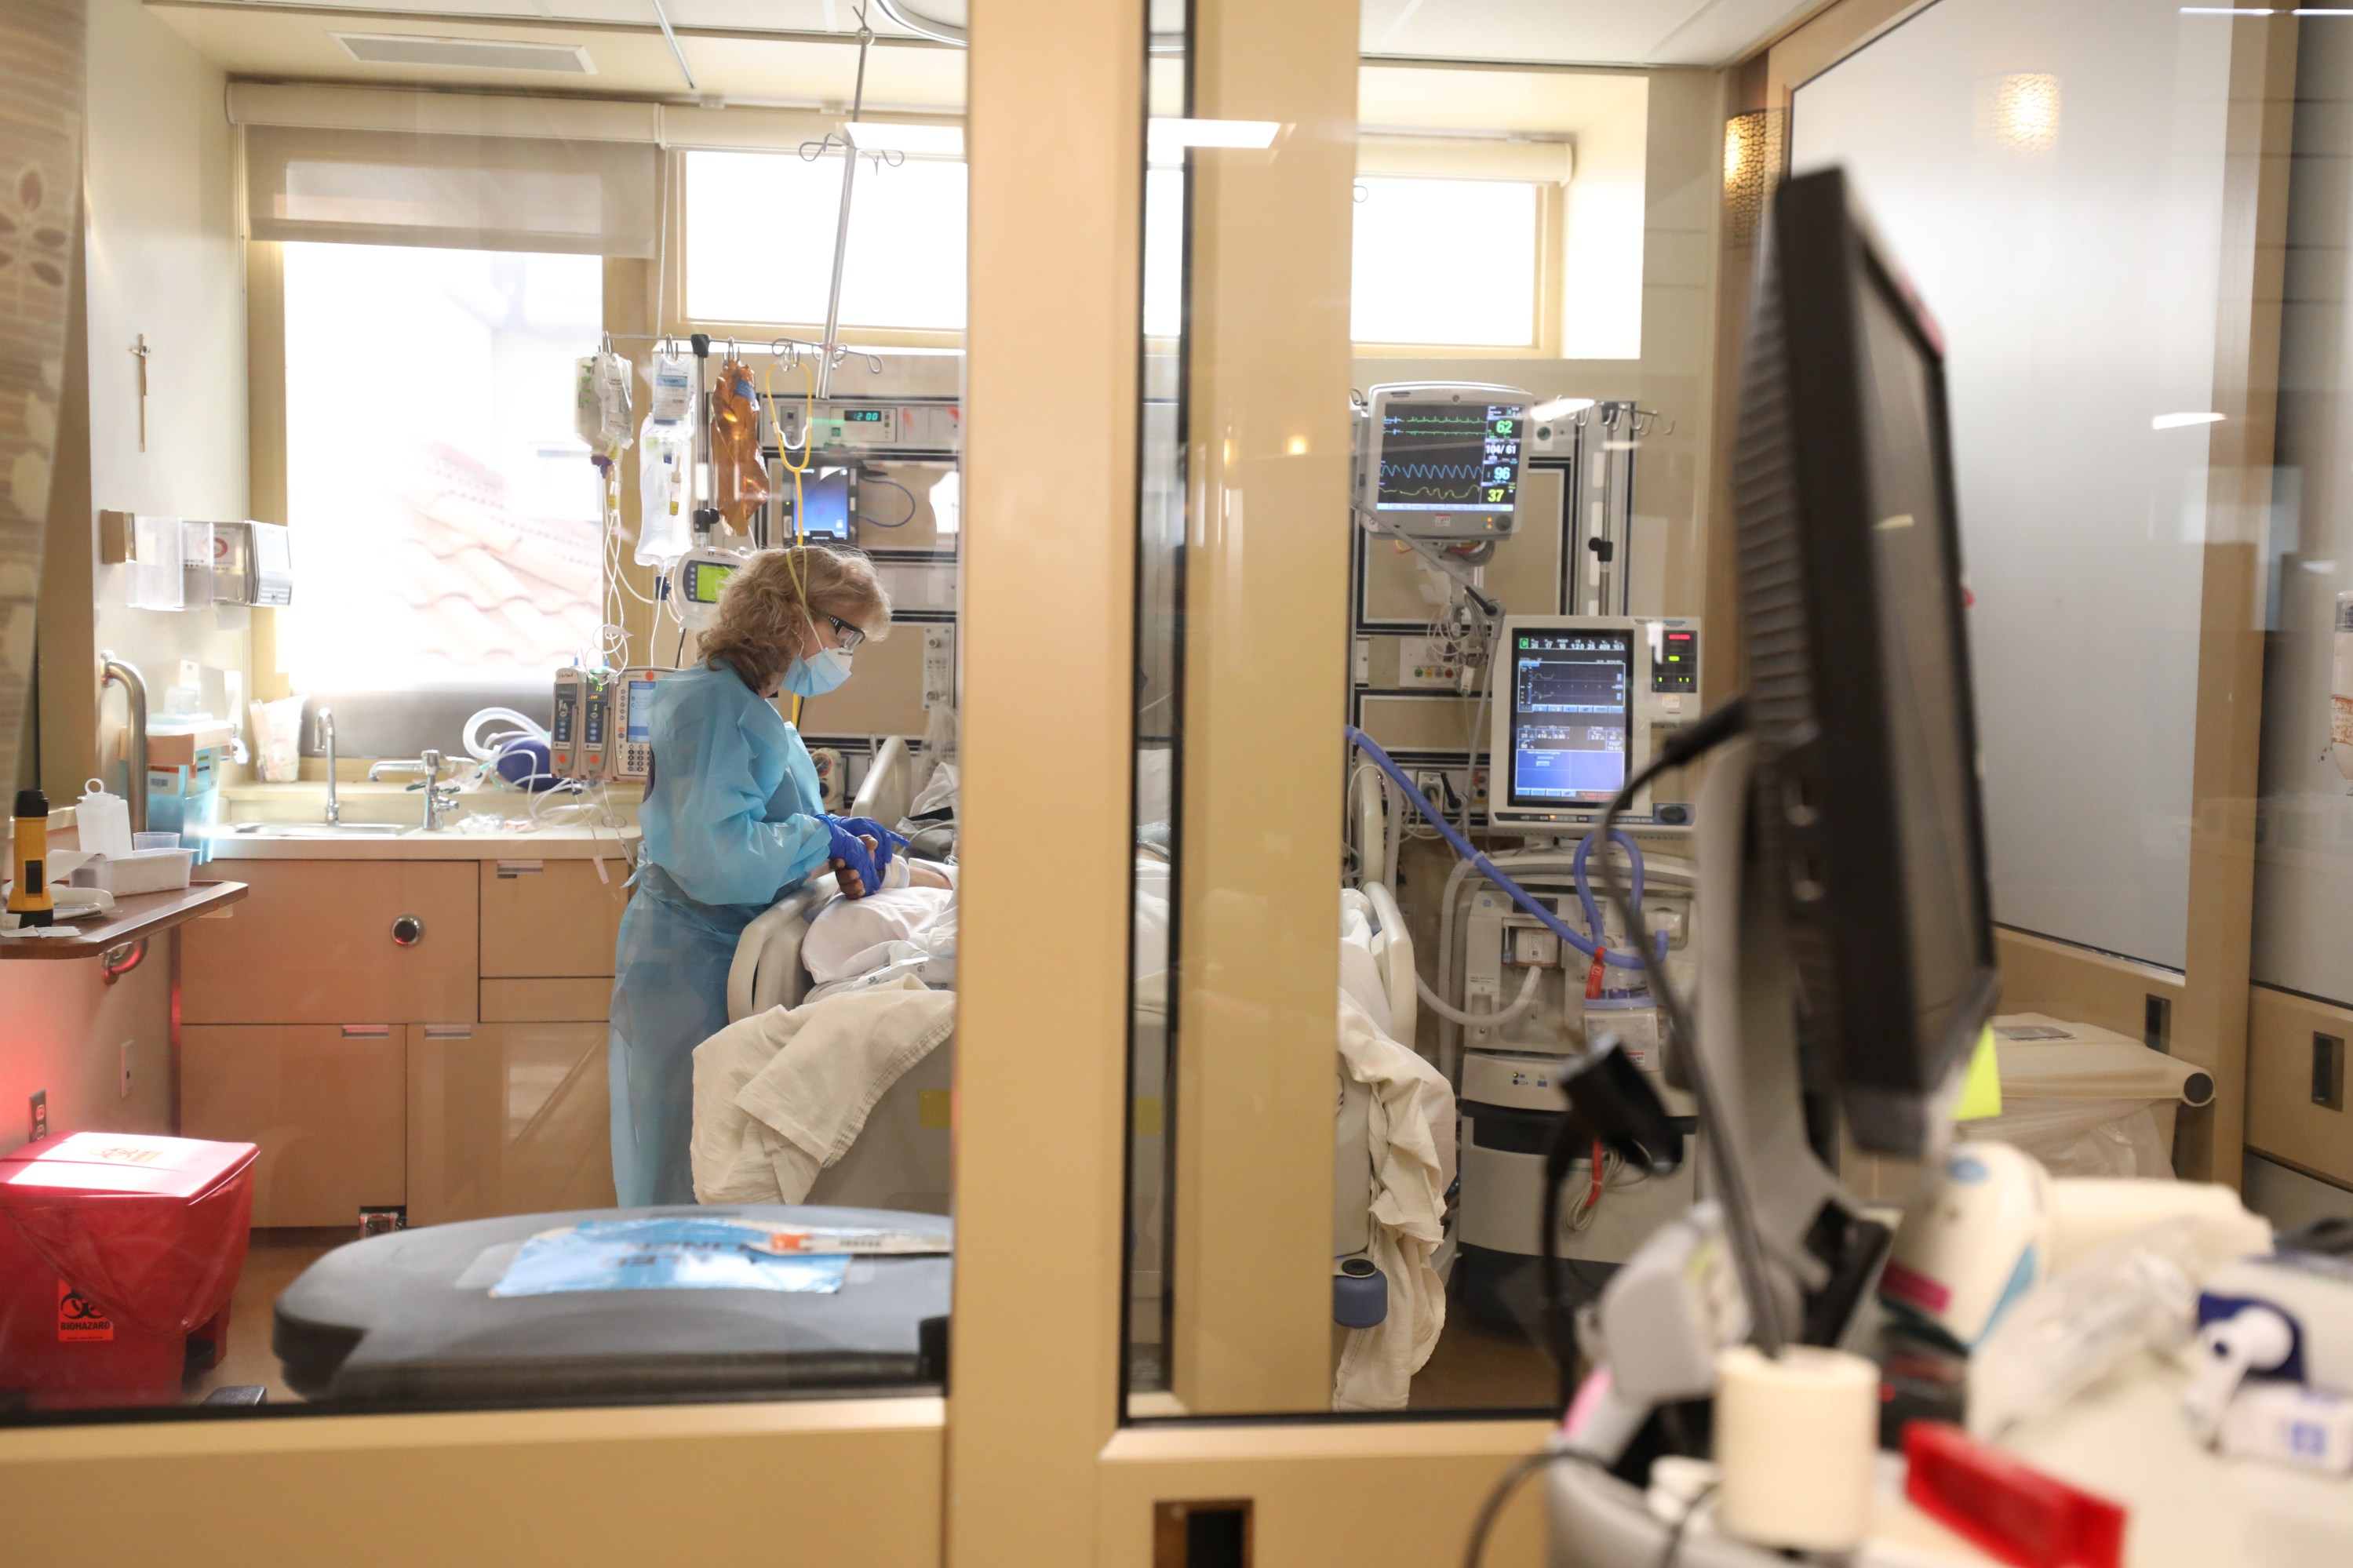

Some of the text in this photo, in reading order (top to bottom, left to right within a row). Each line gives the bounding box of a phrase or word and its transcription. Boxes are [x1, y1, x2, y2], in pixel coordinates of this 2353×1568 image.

[1496, 420, 1513, 433] 62
[1494, 467, 1510, 480] 96
[1488, 489, 1504, 502] 37
[1521, 638, 1528, 648] C
[61, 1322, 111, 1330] BIOHAZARD
